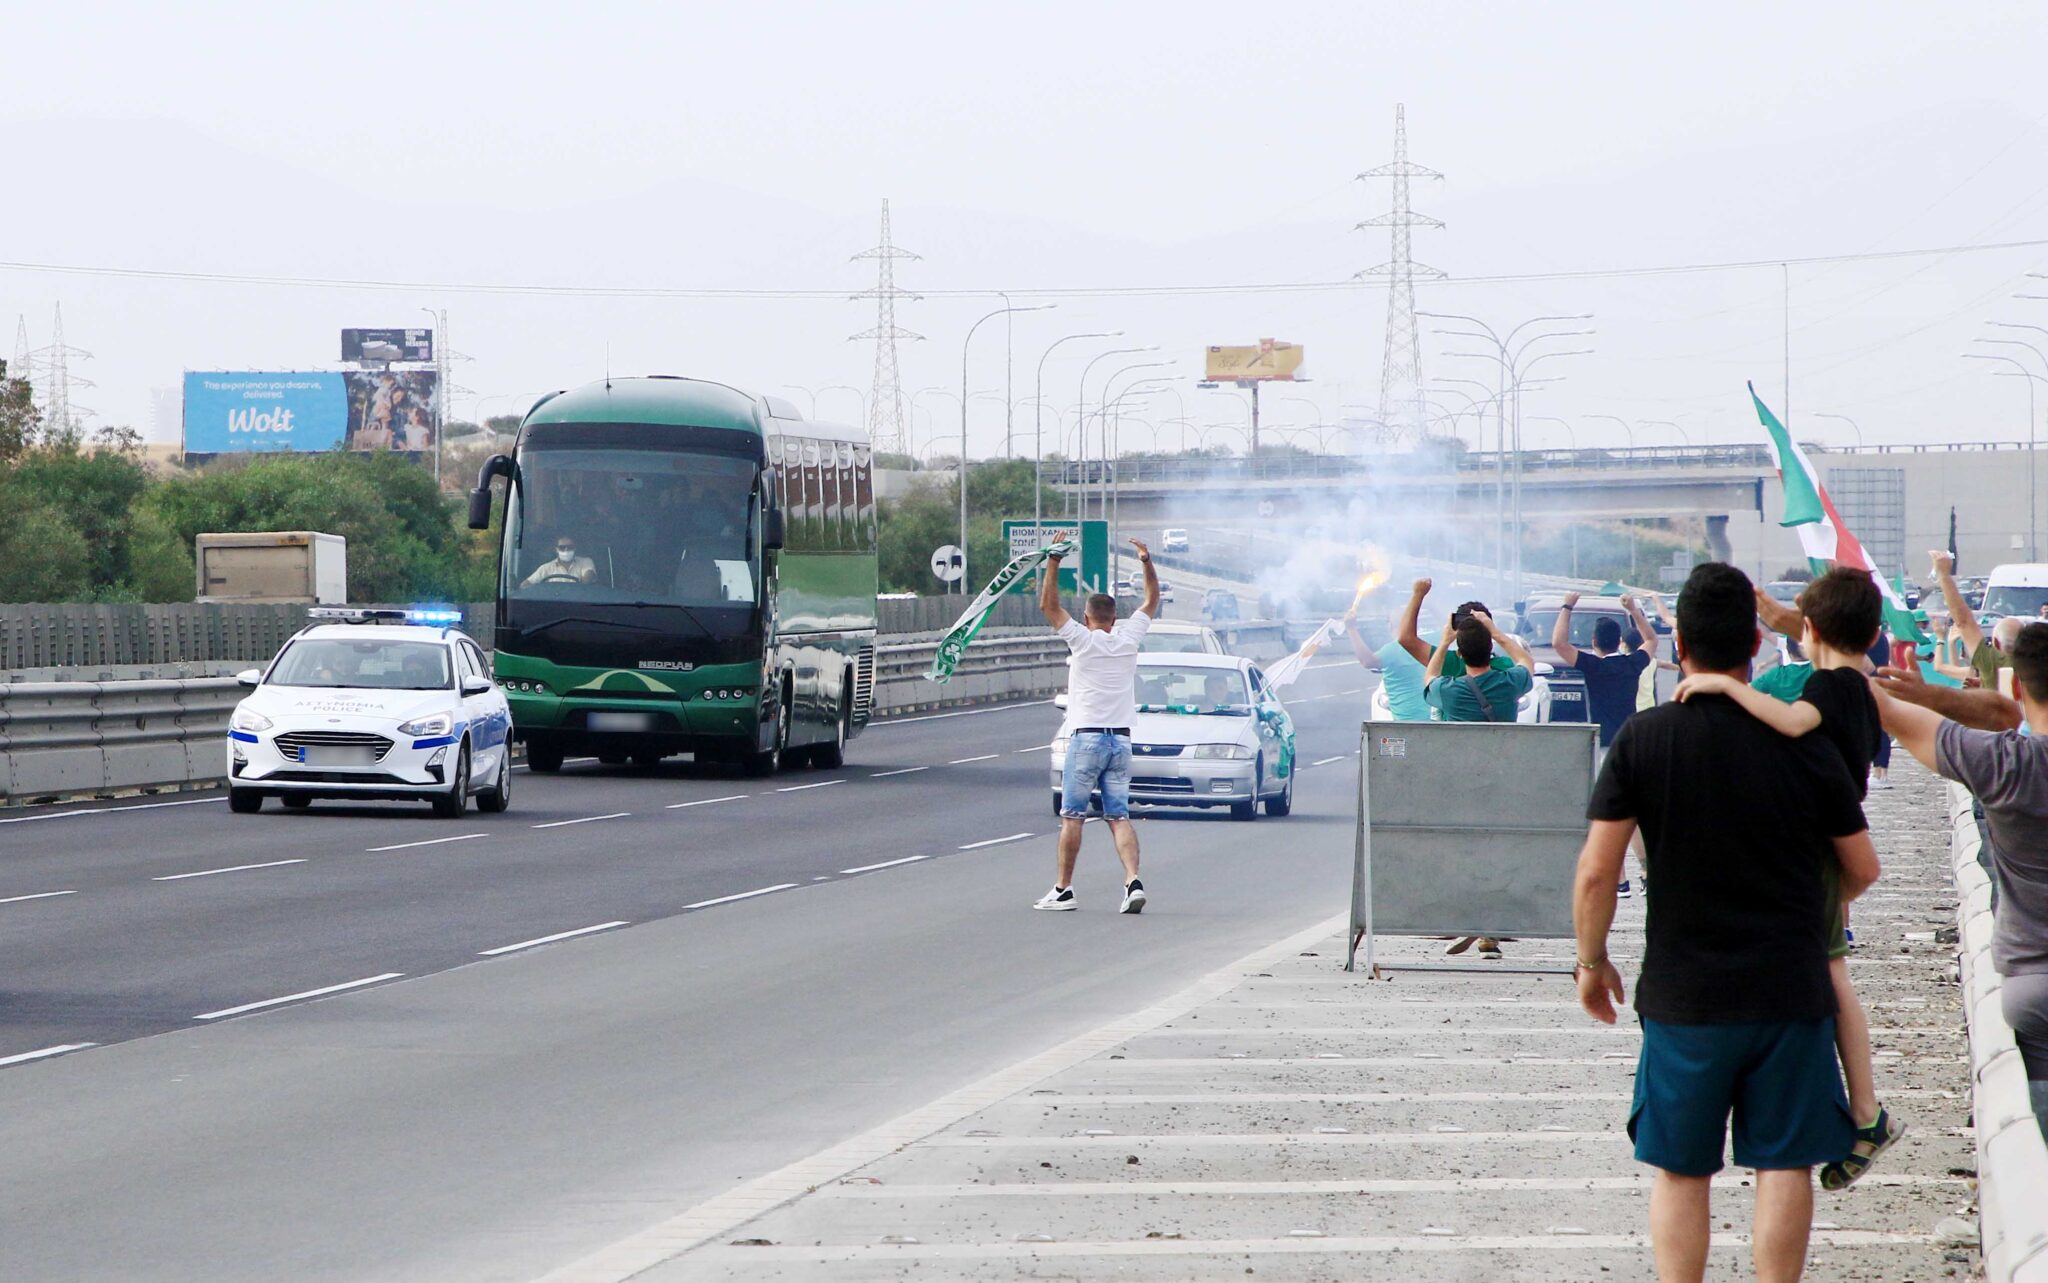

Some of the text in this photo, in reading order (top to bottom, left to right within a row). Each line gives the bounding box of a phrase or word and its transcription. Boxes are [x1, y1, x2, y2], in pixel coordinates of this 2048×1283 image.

[204, 381, 220, 390] The
[221, 381, 268, 391] experience
[269, 383, 285, 391] you
[229, 406, 294, 433] Wolt
[638, 661, 693, 670] NEOPLAN
[295, 701, 384, 710] ΑΣΤΥΝΟΜΙΑ
